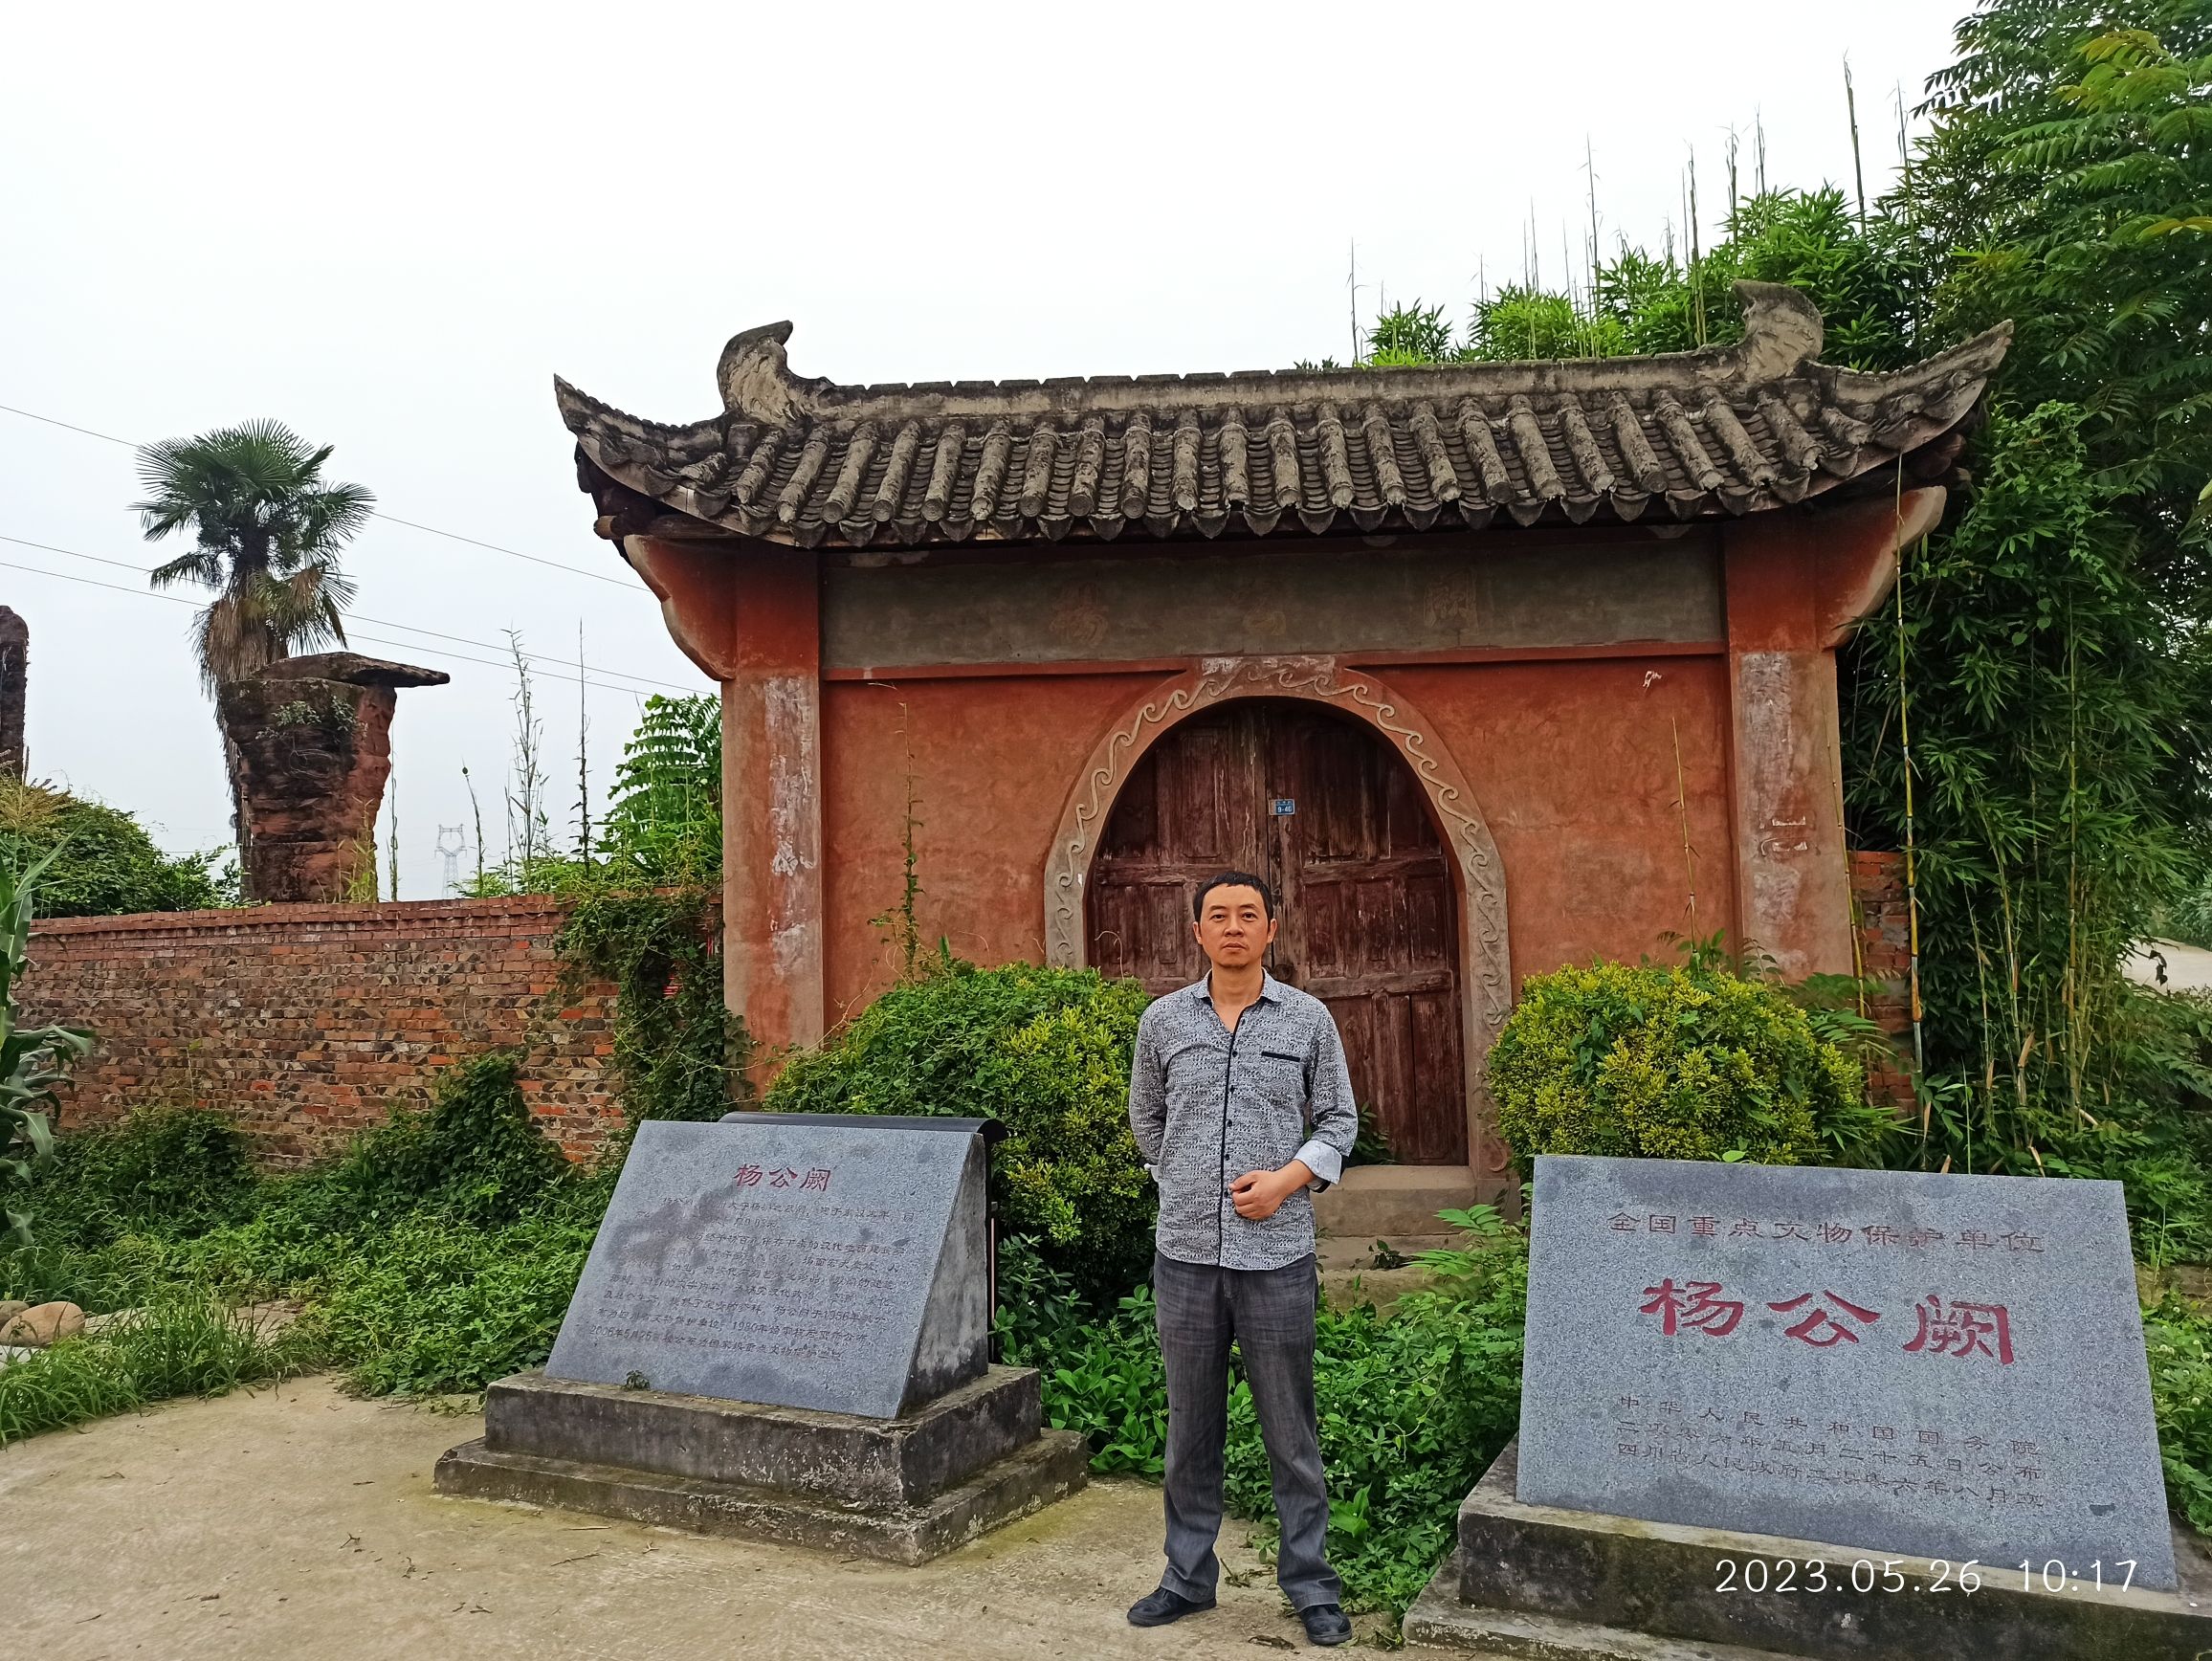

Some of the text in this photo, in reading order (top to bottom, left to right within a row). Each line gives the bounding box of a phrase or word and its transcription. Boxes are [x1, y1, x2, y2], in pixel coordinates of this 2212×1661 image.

[734, 1163, 832, 1192] 杨公阙
[1606, 1211, 2045, 1253] 全国重点文物保护单位
[1639, 1278, 2014, 1365] 杨公阙
[1621, 1396, 2041, 1457] 中华人民共和国国务院
